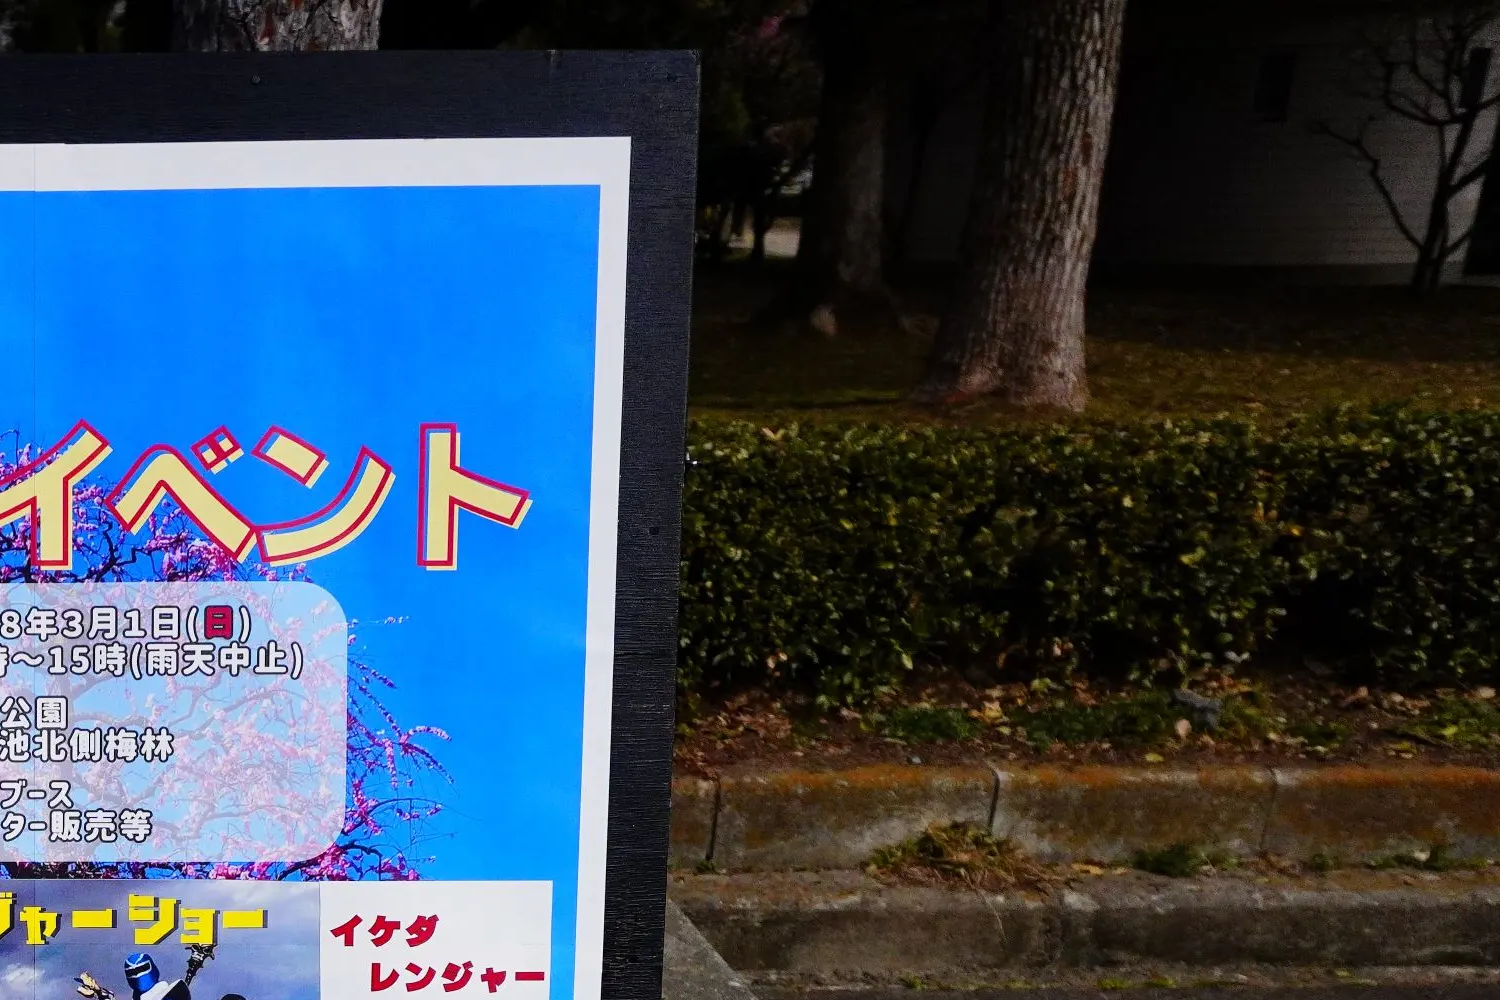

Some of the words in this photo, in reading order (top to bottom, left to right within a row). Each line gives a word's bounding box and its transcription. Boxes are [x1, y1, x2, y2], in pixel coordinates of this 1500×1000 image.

[329, 914, 440, 947] イケダ
[370, 960, 546, 994] レンジャー
